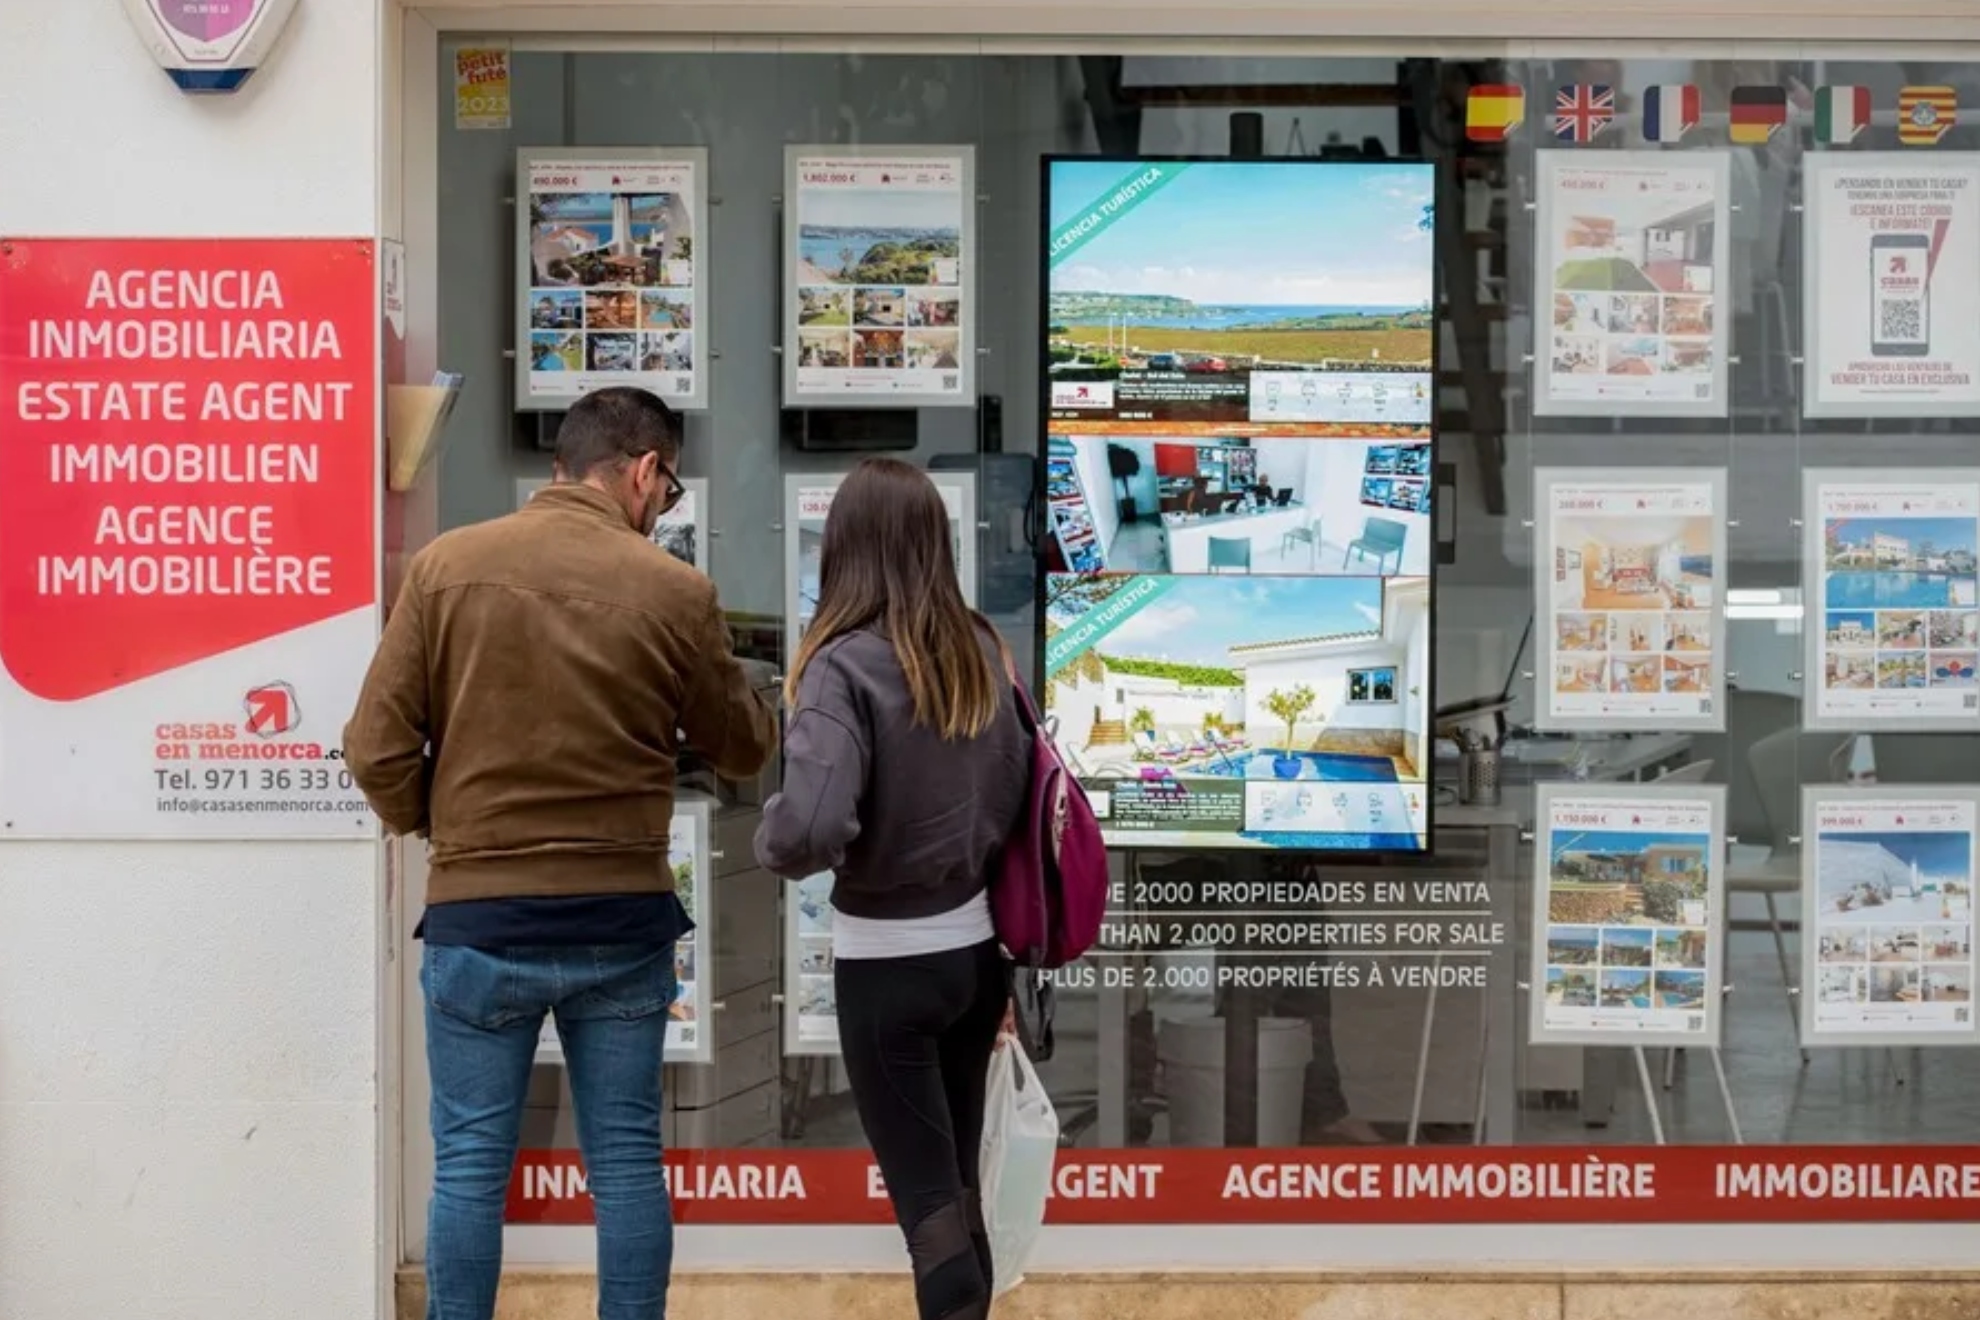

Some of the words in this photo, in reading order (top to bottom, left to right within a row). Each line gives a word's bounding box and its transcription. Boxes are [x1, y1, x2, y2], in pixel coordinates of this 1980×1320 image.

[1100, 167, 1163, 216] TURÍSTICA
[87, 271, 282, 308] AGENCIA
[30, 320, 341, 358] INMOBILIARIA
[18, 382, 186, 420] ESTATE
[200, 382, 353, 420] AGENT
[51, 444, 318, 482] IMMOBILIEN
[95, 506, 273, 544] AGENCE
[38, 547, 331, 594] IMMOBILIÈRE
[155, 722, 237, 741] casas
[155, 743, 190, 761] en
[199, 742, 345, 761] menorca.c
[154, 769, 197, 790] Tel.
[204, 769, 249, 790] 971
[260, 769, 291, 790] 36
[299, 769, 330, 790] 33
[338, 769, 353, 790] 0
[157, 796, 370, 813] info@casasenmenorca.com
[1105, 883, 1126, 902] E
[1135, 882, 1193, 903] 2000
[1202, 883, 1366, 903] PROPIEDADES
[1374, 883, 1405, 902] EN
[1414, 883, 1491, 902] VENTA
[1169, 923, 1236, 945] 2.000
[1245, 923, 1387, 944] PROPERTIES
[1395, 923, 1442, 944] FOR
[1449, 923, 1505, 944] SALE
[1038, 967, 1096, 988] PLUS
[1104, 966, 1134, 987] DE
[1143, 966, 1209, 987] 2.000
[1218, 961, 1360, 988] PROPRIÉTÉS
[1367, 961, 1384, 987] À
[1391, 965, 1487, 987] VENDRE
[1045, 1164, 1163, 1199] GENT
[1221, 1164, 1381, 1199] AGENCE
[1393, 1155, 1655, 1198] IMMOBILIÈRE
[1715, 1163, 1980, 1198] IMMOBILIARE
